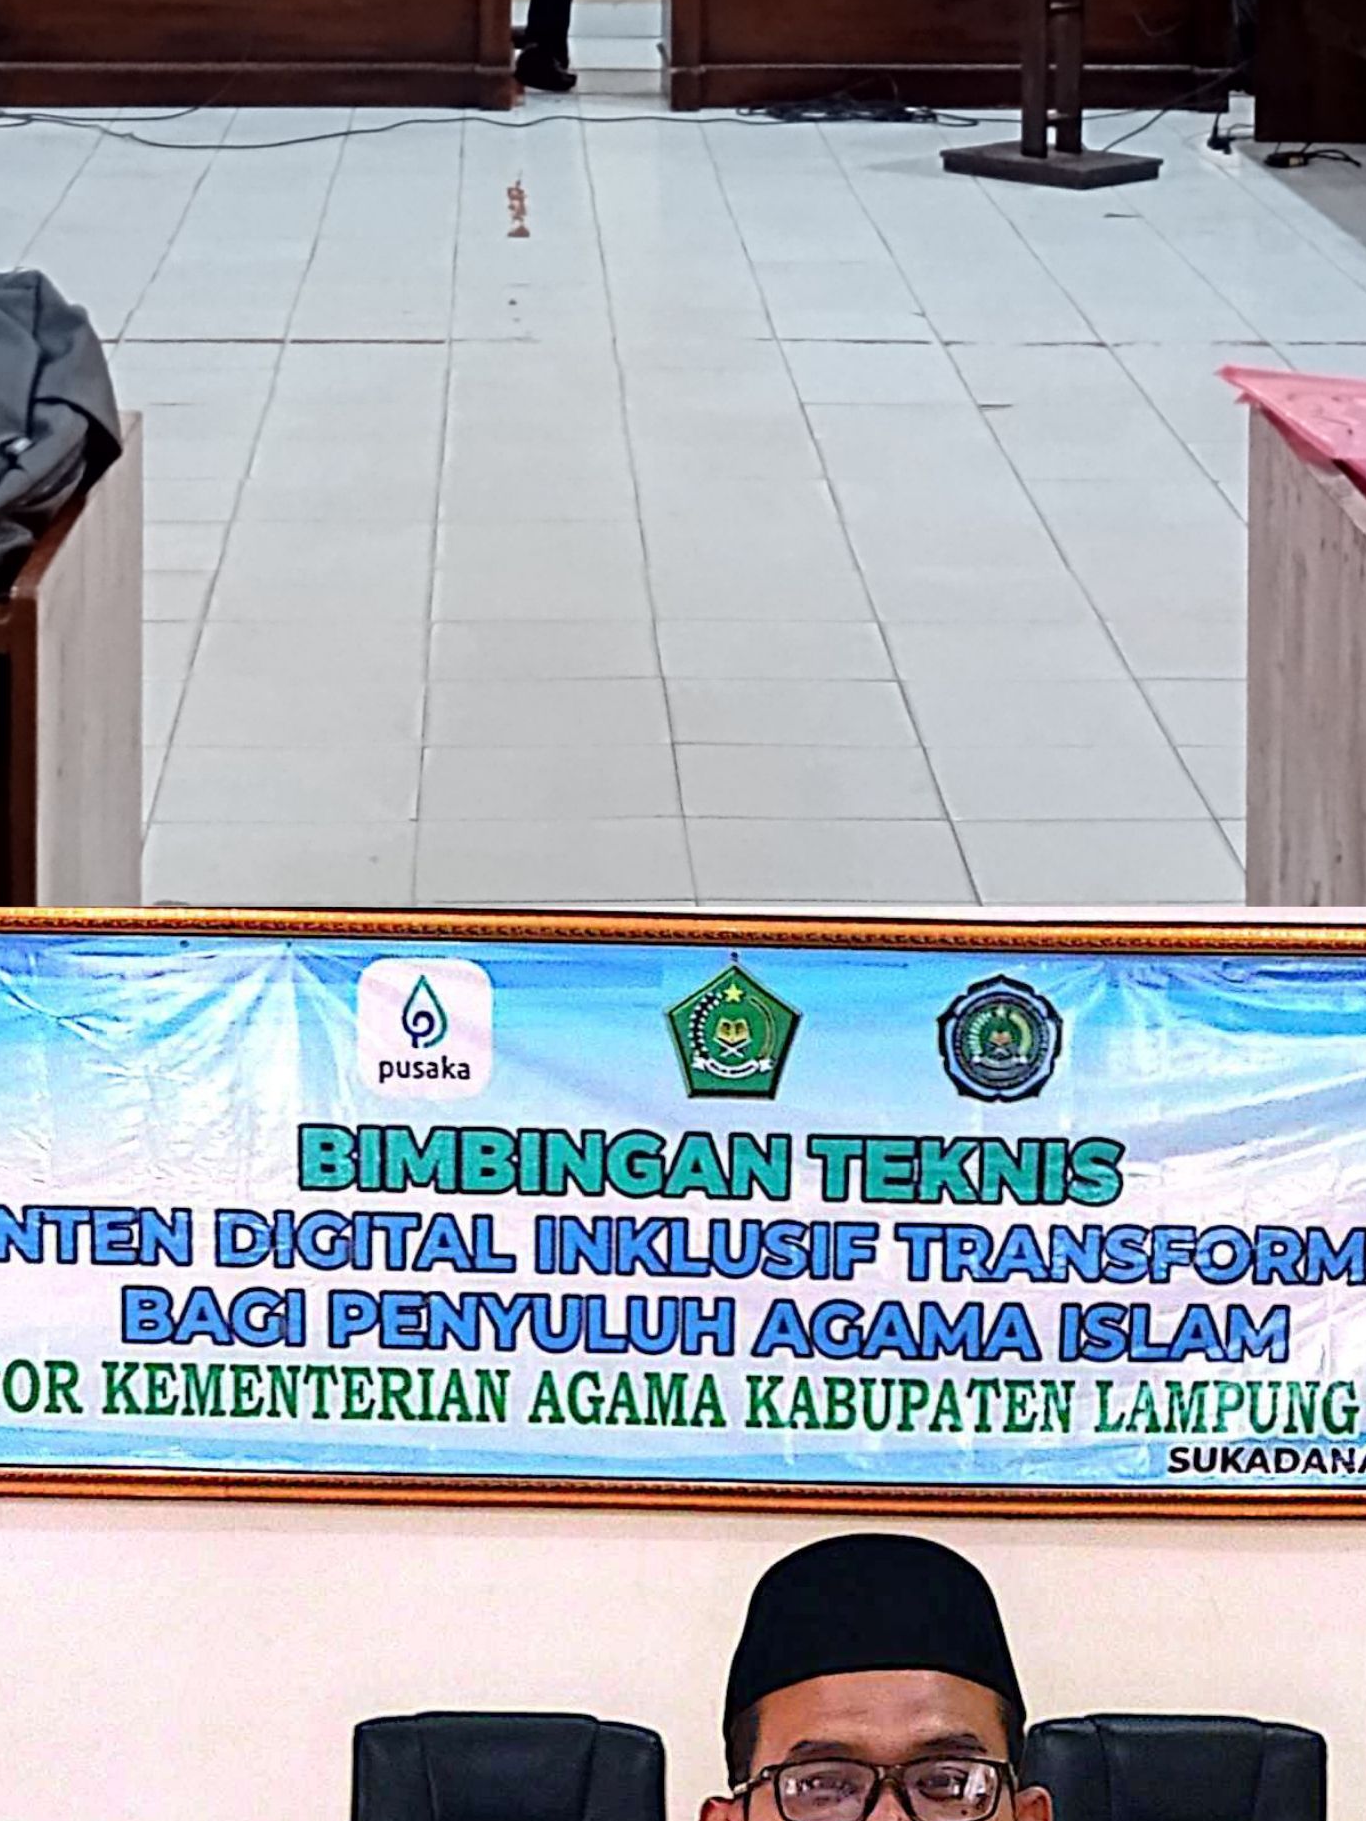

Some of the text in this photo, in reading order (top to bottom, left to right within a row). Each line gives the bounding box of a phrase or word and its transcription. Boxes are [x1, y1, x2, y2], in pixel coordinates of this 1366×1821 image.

[379, 1055, 471, 1084] pusaka
[298, 1124, 1125, 1207] BIMBINGAN TEKNIS
[215, 1209, 516, 1271] DIGITAL
[534, 1214, 877, 1280] INKLUSIF
[121, 1285, 1291, 1363] BAGI PENYULUH AGAMA ISLAM
[101, 1361, 510, 1423] KEMENTERIAN
[527, 1370, 726, 1429] AGAMA
[745, 1374, 1076, 1433] KABUPATEN
[1093, 1379, 1361, 1436] LAMPUNG
